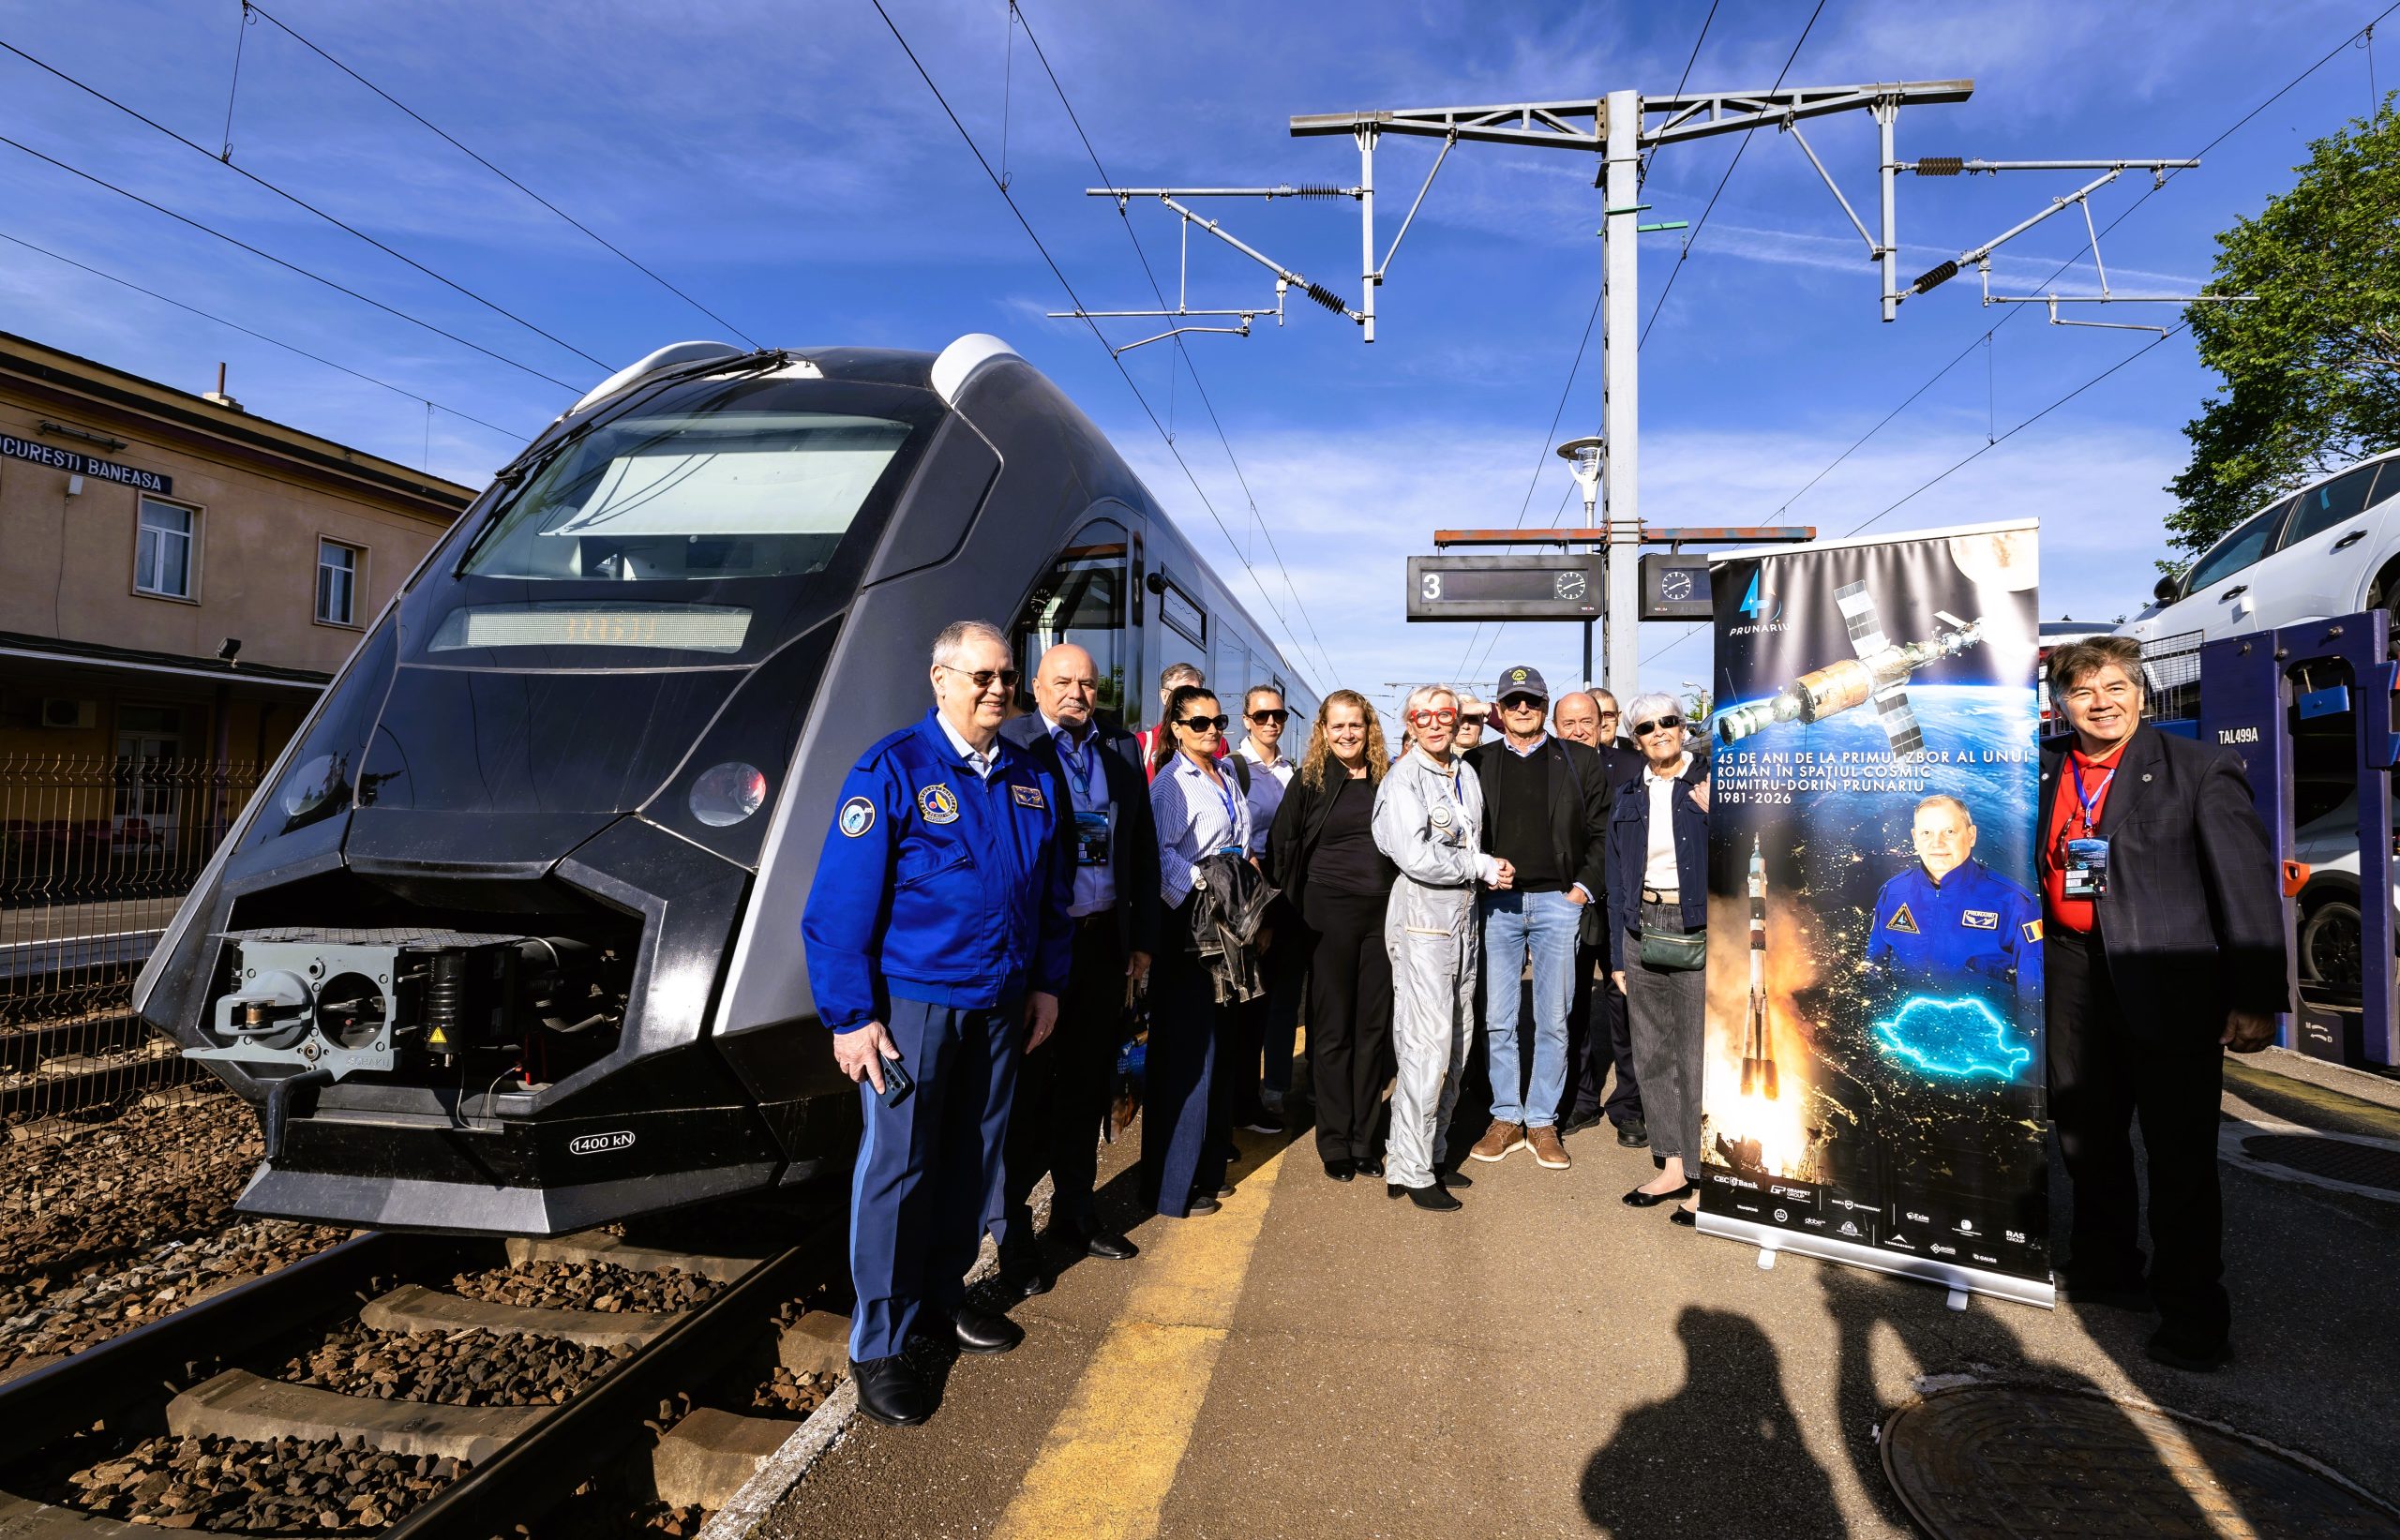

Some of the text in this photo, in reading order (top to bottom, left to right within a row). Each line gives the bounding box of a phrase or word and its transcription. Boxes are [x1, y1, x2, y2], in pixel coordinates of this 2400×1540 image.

[0, 438, 161, 491] CUREȘTI BANEASA
[1423, 574, 1441, 600] 3
[1729, 622, 1792, 636] PRUNARIU
[2218, 727, 2259, 745] TAL499A
[1718, 751, 2029, 764] 45 DE ANI DE LA PRIMUL ZBOR AL UNUI
[1718, 764, 1770, 777] ROMÂN
[1777, 764, 1792, 777] ÎN
[1863, 765, 1932, 778] COSMIC
[1718, 779, 1924, 792] DUMITRU-DORIN PRUNARIU
[1718, 792, 1792, 804] 1981-2026
[573, 1133, 633, 1152] 1400 kN
[1714, 1174, 1759, 1189] CEC Bank
[1786, 1187, 1811, 1196] GRAMPET
[2005, 1230, 2025, 1239] RAS
